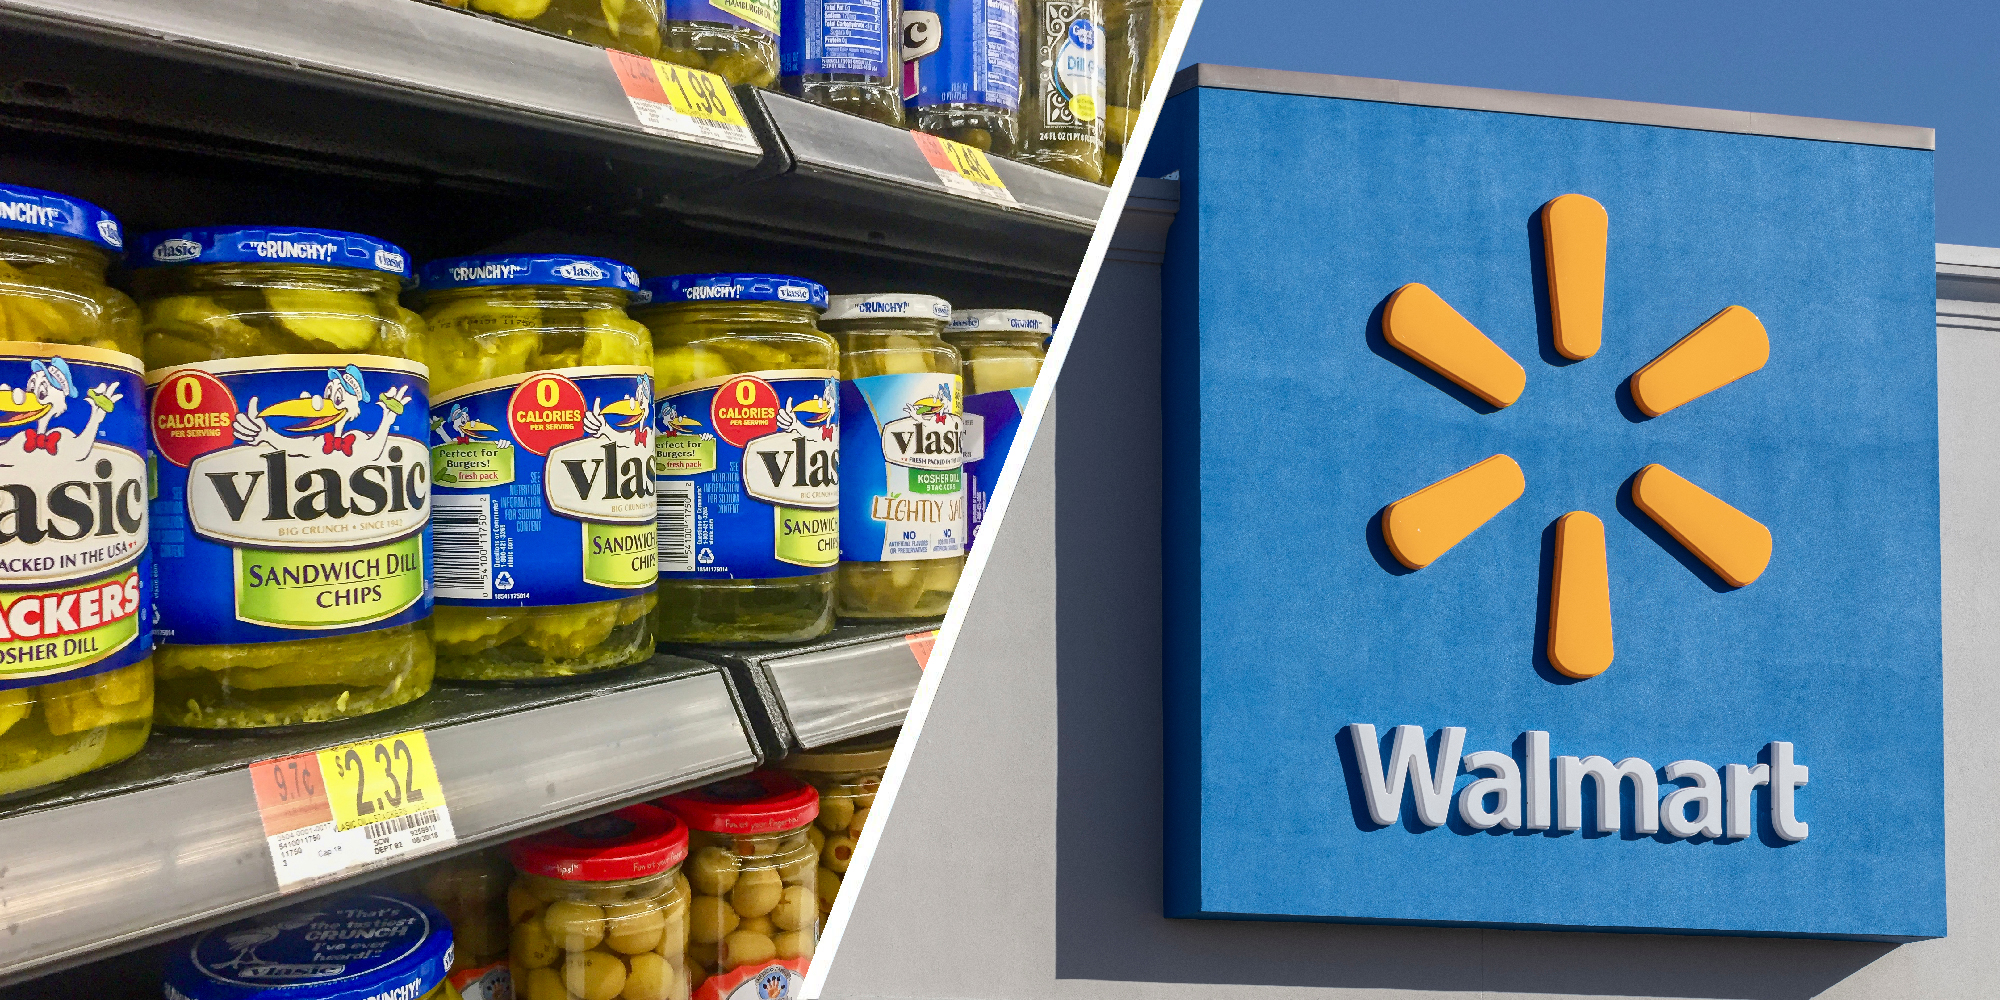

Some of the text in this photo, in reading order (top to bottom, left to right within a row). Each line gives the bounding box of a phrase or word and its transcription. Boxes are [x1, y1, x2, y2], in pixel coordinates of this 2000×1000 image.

[1067, 55, 1084, 71] Dill
[176, 376, 203, 410] 0
[536, 379, 560, 408] 0
[735, 380, 757, 406] 0
[157, 412, 231, 429] CALORIES
[516, 409, 582, 423] CALORIES
[718, 407, 775, 419] CALORIES
[170, 428, 221, 438] PER SERVING
[545, 423, 575, 431] SERVING
[687, 440, 702, 448] for
[439, 448, 499, 458] Perfect for
[656, 450, 695, 459] Burgers!
[446, 459, 491, 470] Burgers!
[685, 461, 702, 469] pack
[204, 445, 427, 522] vlasic
[458, 471, 499, 482] fresh pack
[917, 473, 960, 484] KOSHER DILL
[872, 495, 943, 524] LIGHTLY
[278, 527, 299, 537] BIG
[301, 524, 349, 535] CRUNCH
[359, 520, 385, 531] SINCE
[903, 530, 917, 540] NO
[60, 553, 77, 569] IN
[80, 547, 104, 565] THE
[107, 541, 128, 558] USA
[249, 552, 417, 588] SANDWICH DILL
[316, 584, 382, 609] CHIPS
[63, 636, 98, 657] DILL
[335, 739, 425, 817] $2.32
[1350, 723, 1809, 842] Walmart
[633, 862, 646, 872] Fun
[647, 861, 656, 869] at
[304, 925, 409, 942] CRUNCH
[310, 921, 341, 930] the
